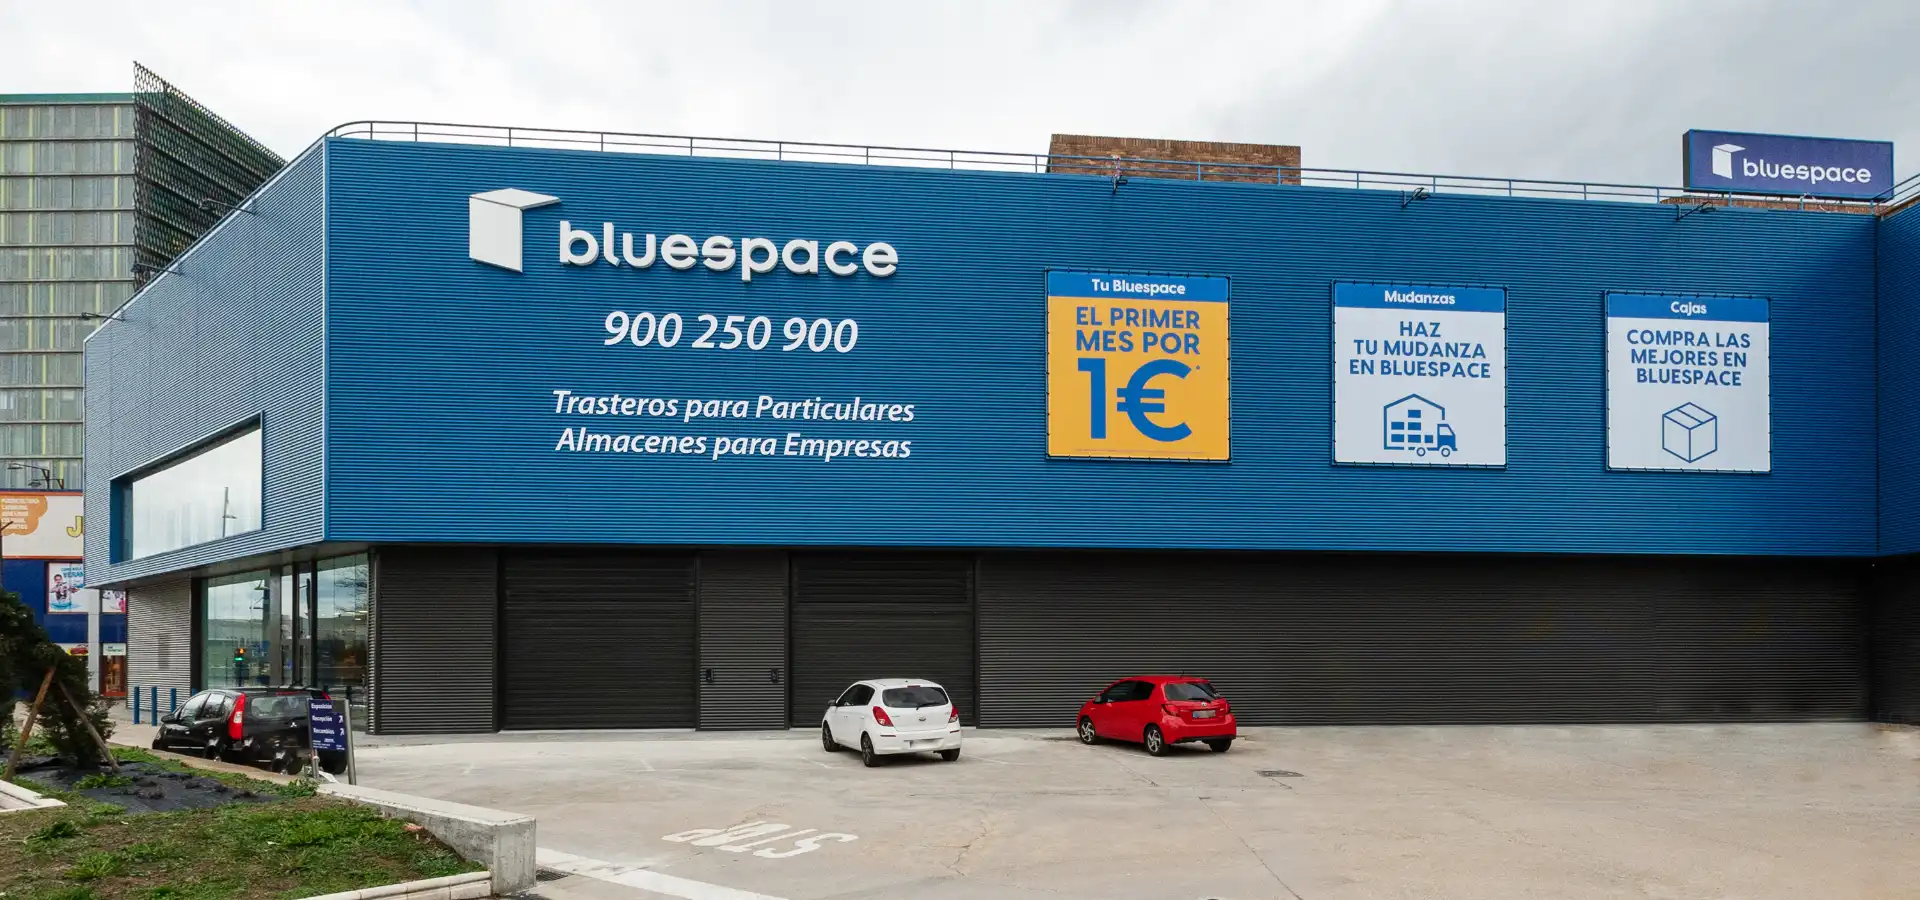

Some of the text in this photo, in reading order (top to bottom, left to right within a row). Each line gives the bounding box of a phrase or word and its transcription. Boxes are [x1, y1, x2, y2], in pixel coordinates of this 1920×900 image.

[1743, 158, 1872, 185] bluespace
[559, 220, 899, 282] bluespace
[1091, 278, 1186, 296] Tu Bluespace
[1384, 290, 1456, 305] Mudanzas
[1076, 306, 1201, 330] EL PRIMER
[1670, 301, 1707, 316] Cajas
[604, 310, 859, 353] 900 250 900
[1399, 320, 1441, 338] HAZ
[1626, 329, 1751, 349] COMPRA LAS
[1076, 329, 1201, 355] MES POR
[1353, 339, 1487, 359] TU MUDANZA
[1349, 358, 1491, 379] EN BLUESPACE
[1631, 348, 1747, 368] MEJORES EN
[1636, 367, 1742, 387] BLUESPACE
[552, 390, 915, 423] Trasteros para Particulares
[555, 426, 912, 463] Almacenes para Empresas
[661, 820, 859, 859] STOP
